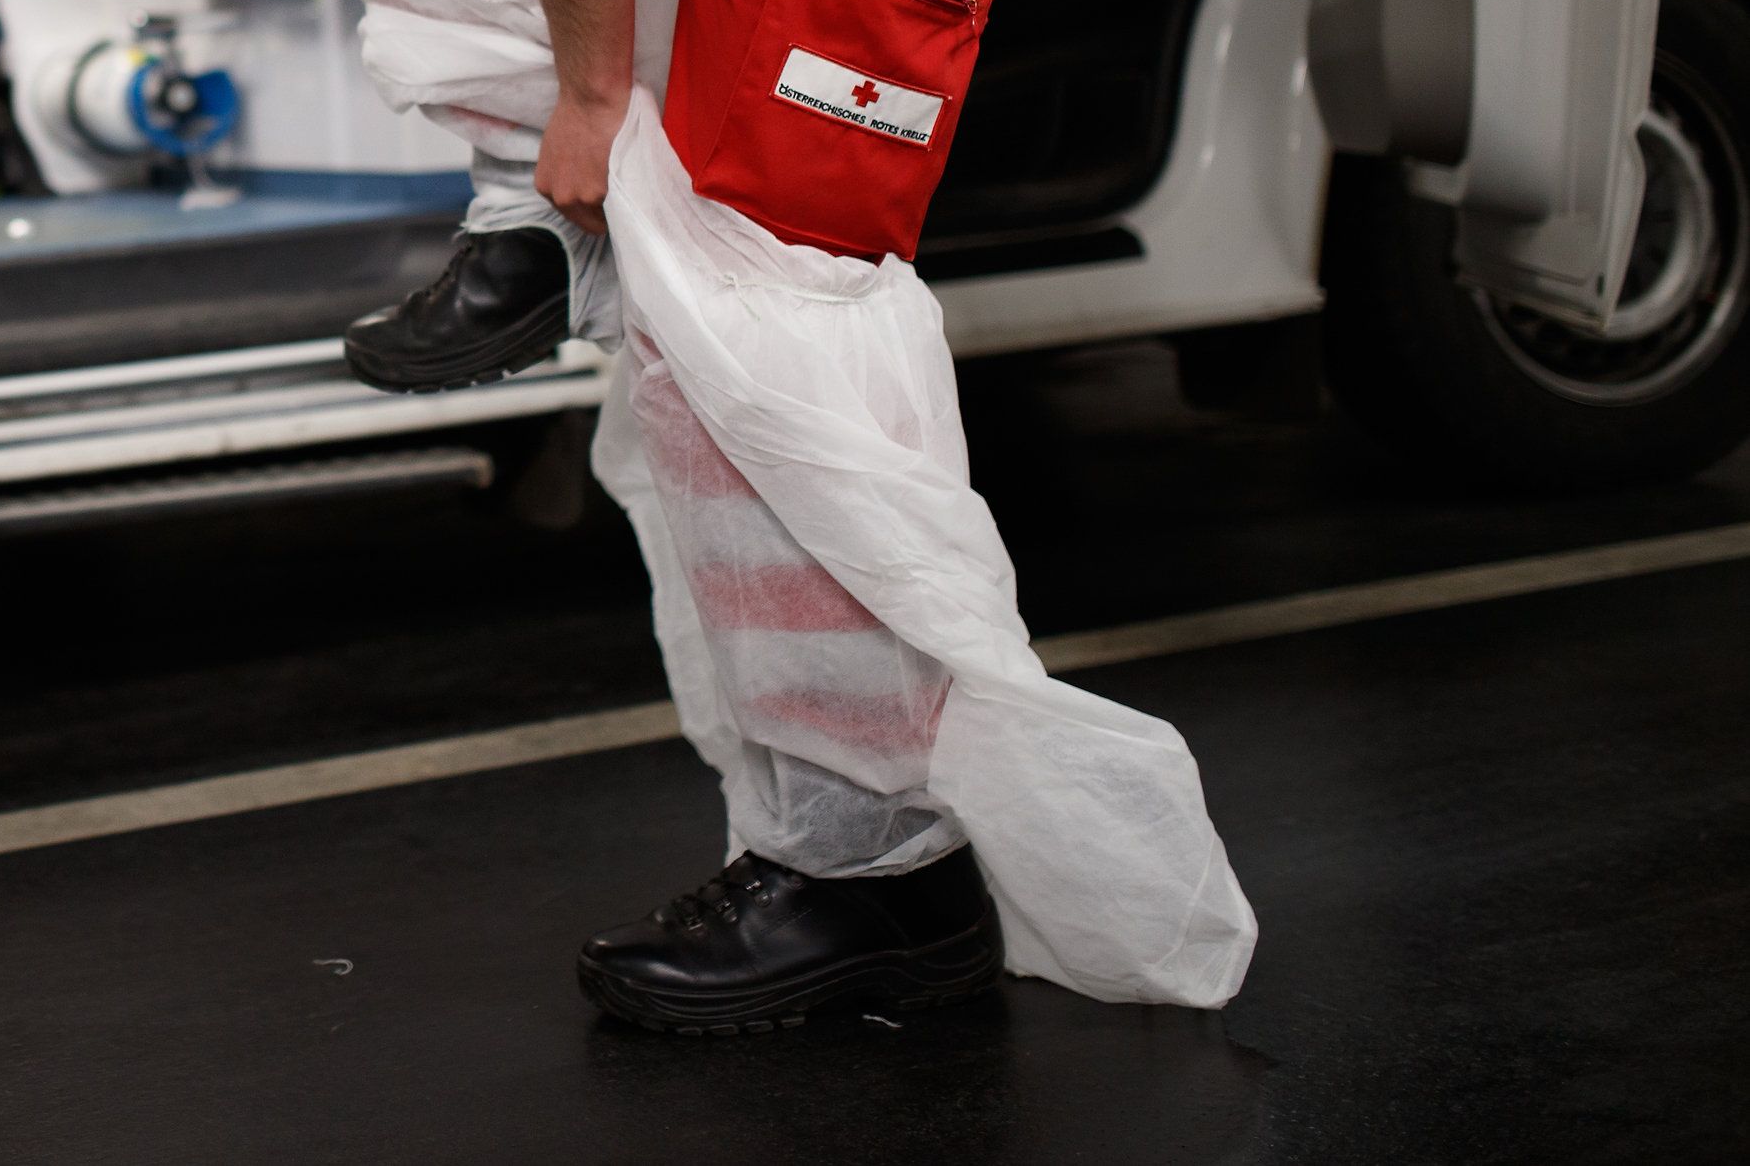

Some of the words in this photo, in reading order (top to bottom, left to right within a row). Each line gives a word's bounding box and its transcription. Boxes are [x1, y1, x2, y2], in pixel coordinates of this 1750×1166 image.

[778, 83, 867, 124] ÖSTERREICHISCHES
[870, 119, 900, 135] ROTES
[900, 128, 929, 142] KREUZ
